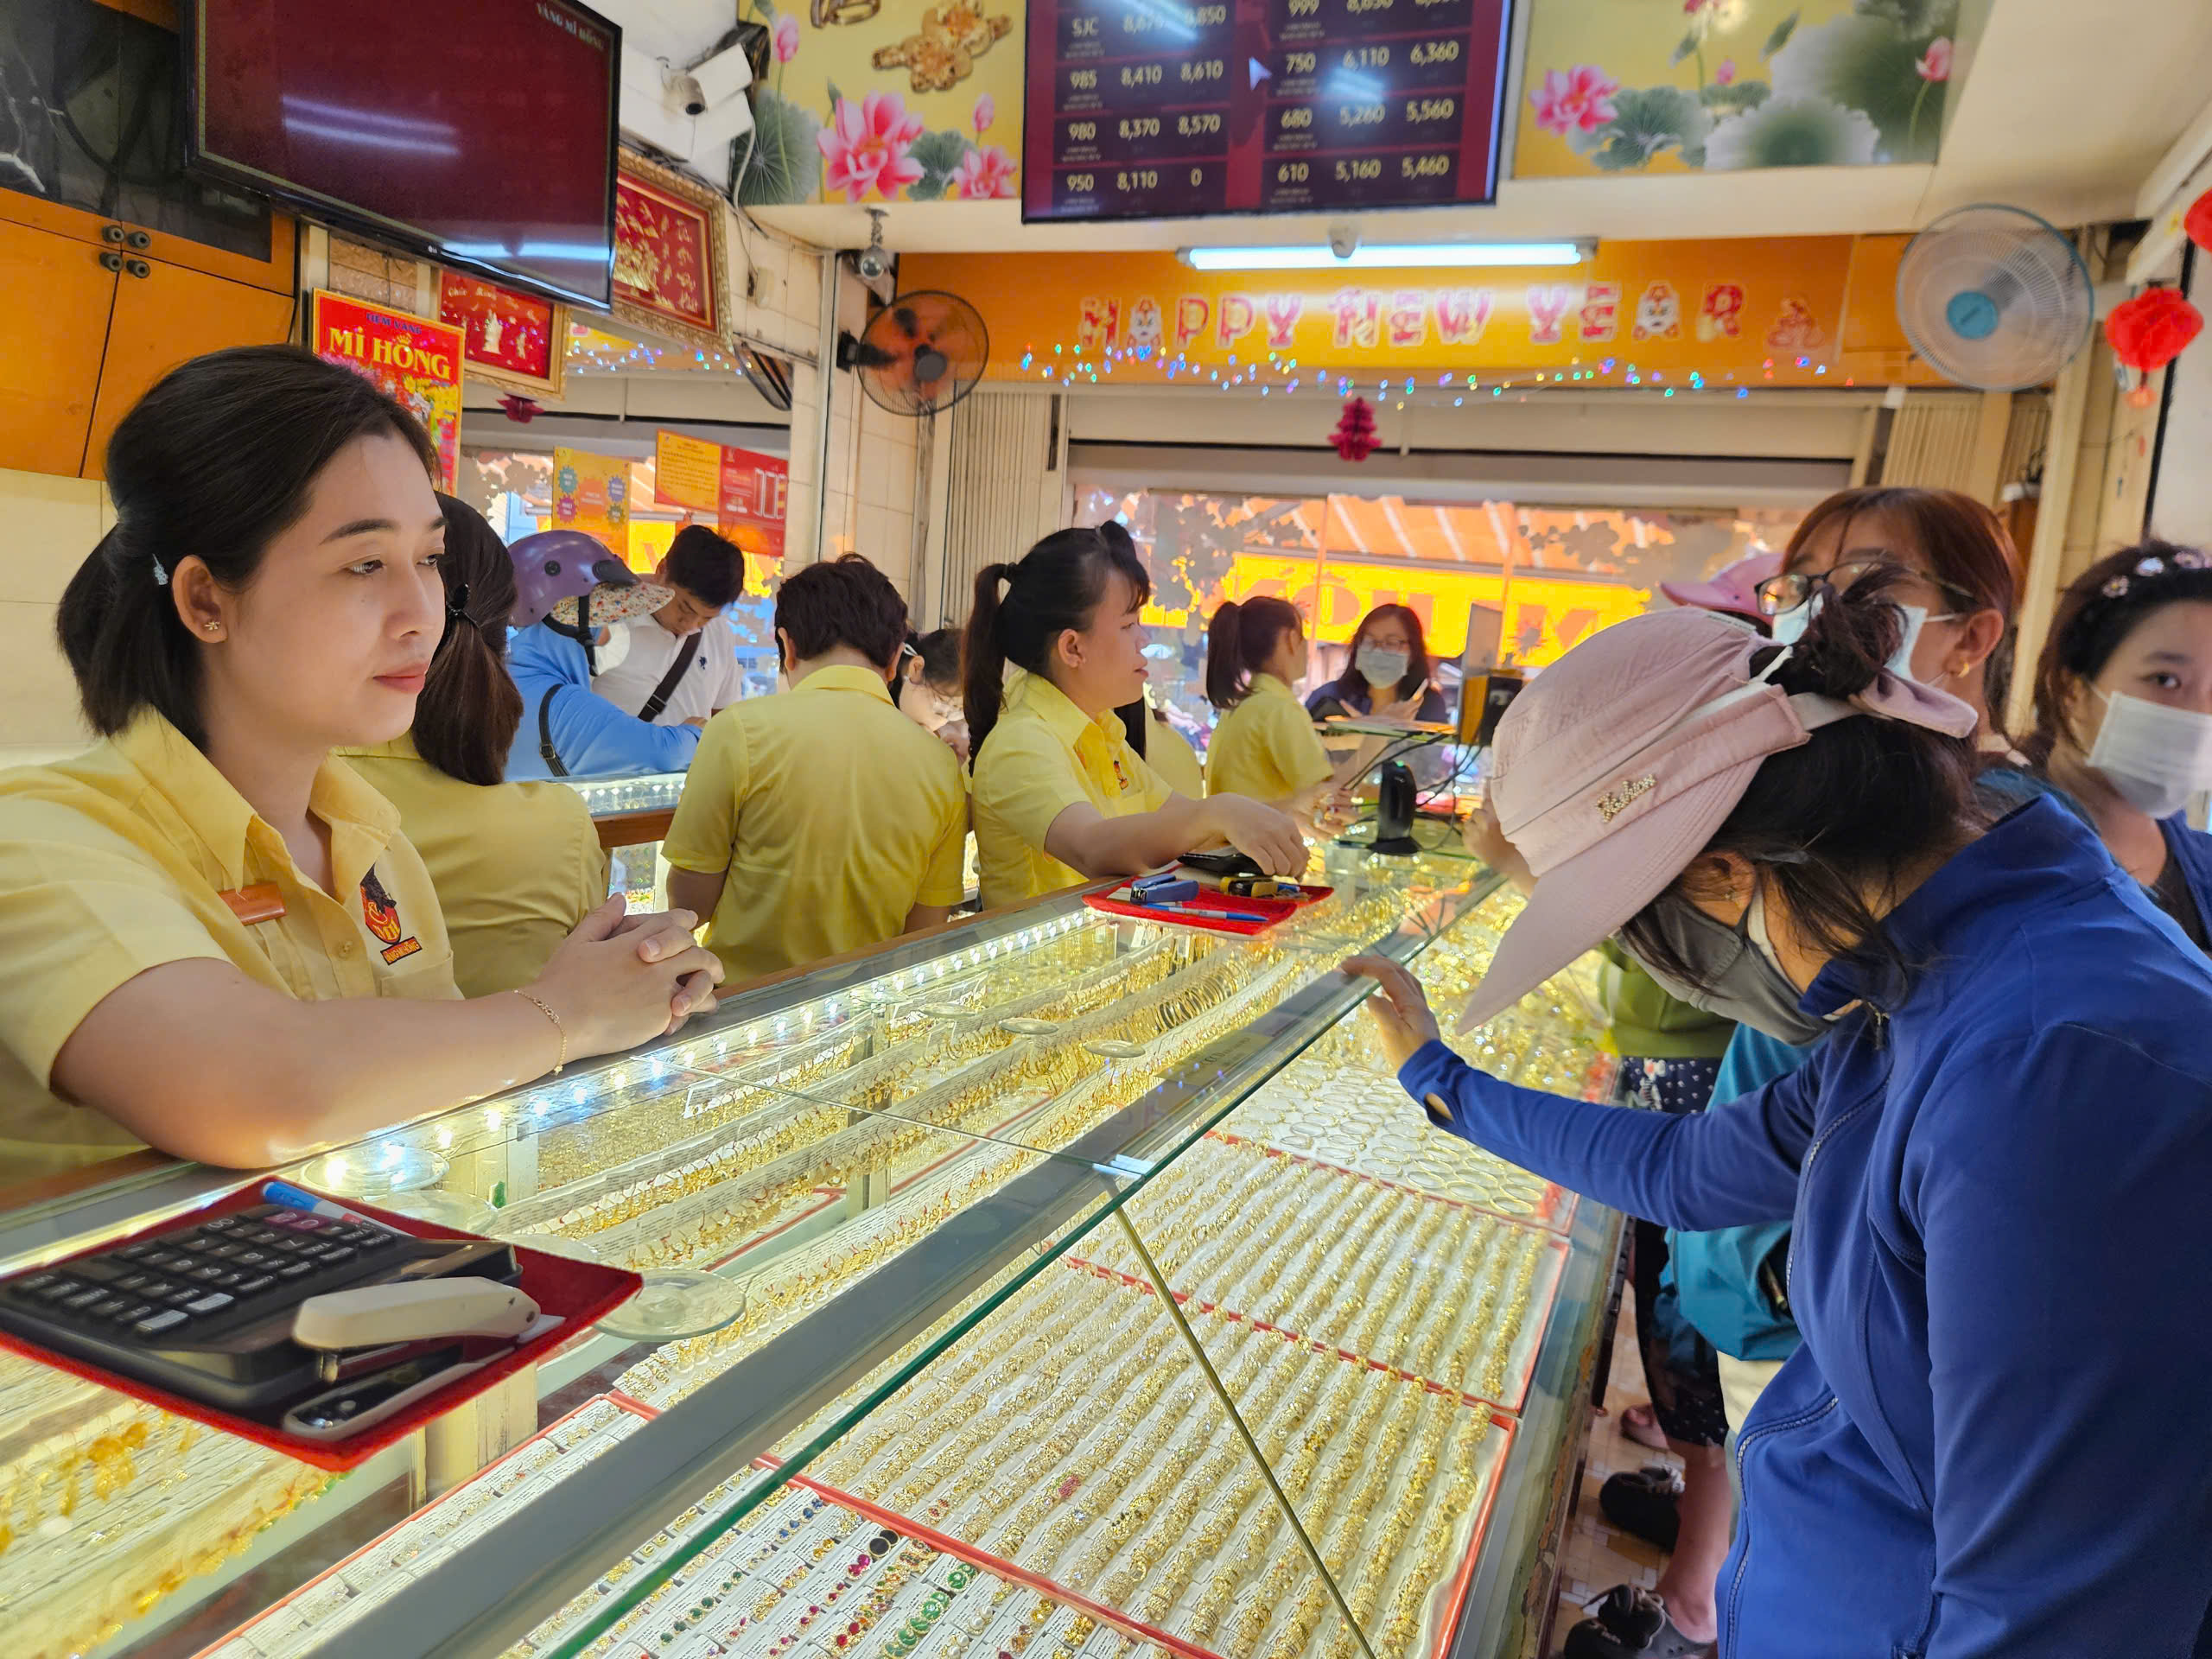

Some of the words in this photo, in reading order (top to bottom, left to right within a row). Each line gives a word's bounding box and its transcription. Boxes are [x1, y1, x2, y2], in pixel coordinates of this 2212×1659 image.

[1071, 16, 1099, 37] SJC
[1286, 53, 1316, 74] 750
[1344, 47, 1390, 70] 6,110
[1410, 41, 1459, 67] 6,360
[1070, 69, 1097, 90] 985
[1120, 64, 1162, 87] 8,410
[1180, 60, 1224, 84] 8,610
[1406, 99, 1455, 124] 5,560
[1068, 121, 1096, 141] 980
[1119, 118, 1160, 141] 8,370
[1178, 114, 1220, 137] 8,570
[1066, 174, 1094, 192] 950
[1116, 170, 1158, 193] 8,110
[1190, 168, 1203, 187] 0
[1278, 162, 1309, 182] 610
[1335, 159, 1382, 182] 5,160
[1402, 155, 1450, 180] 5,460
[1327, 286, 1495, 347] NEW
